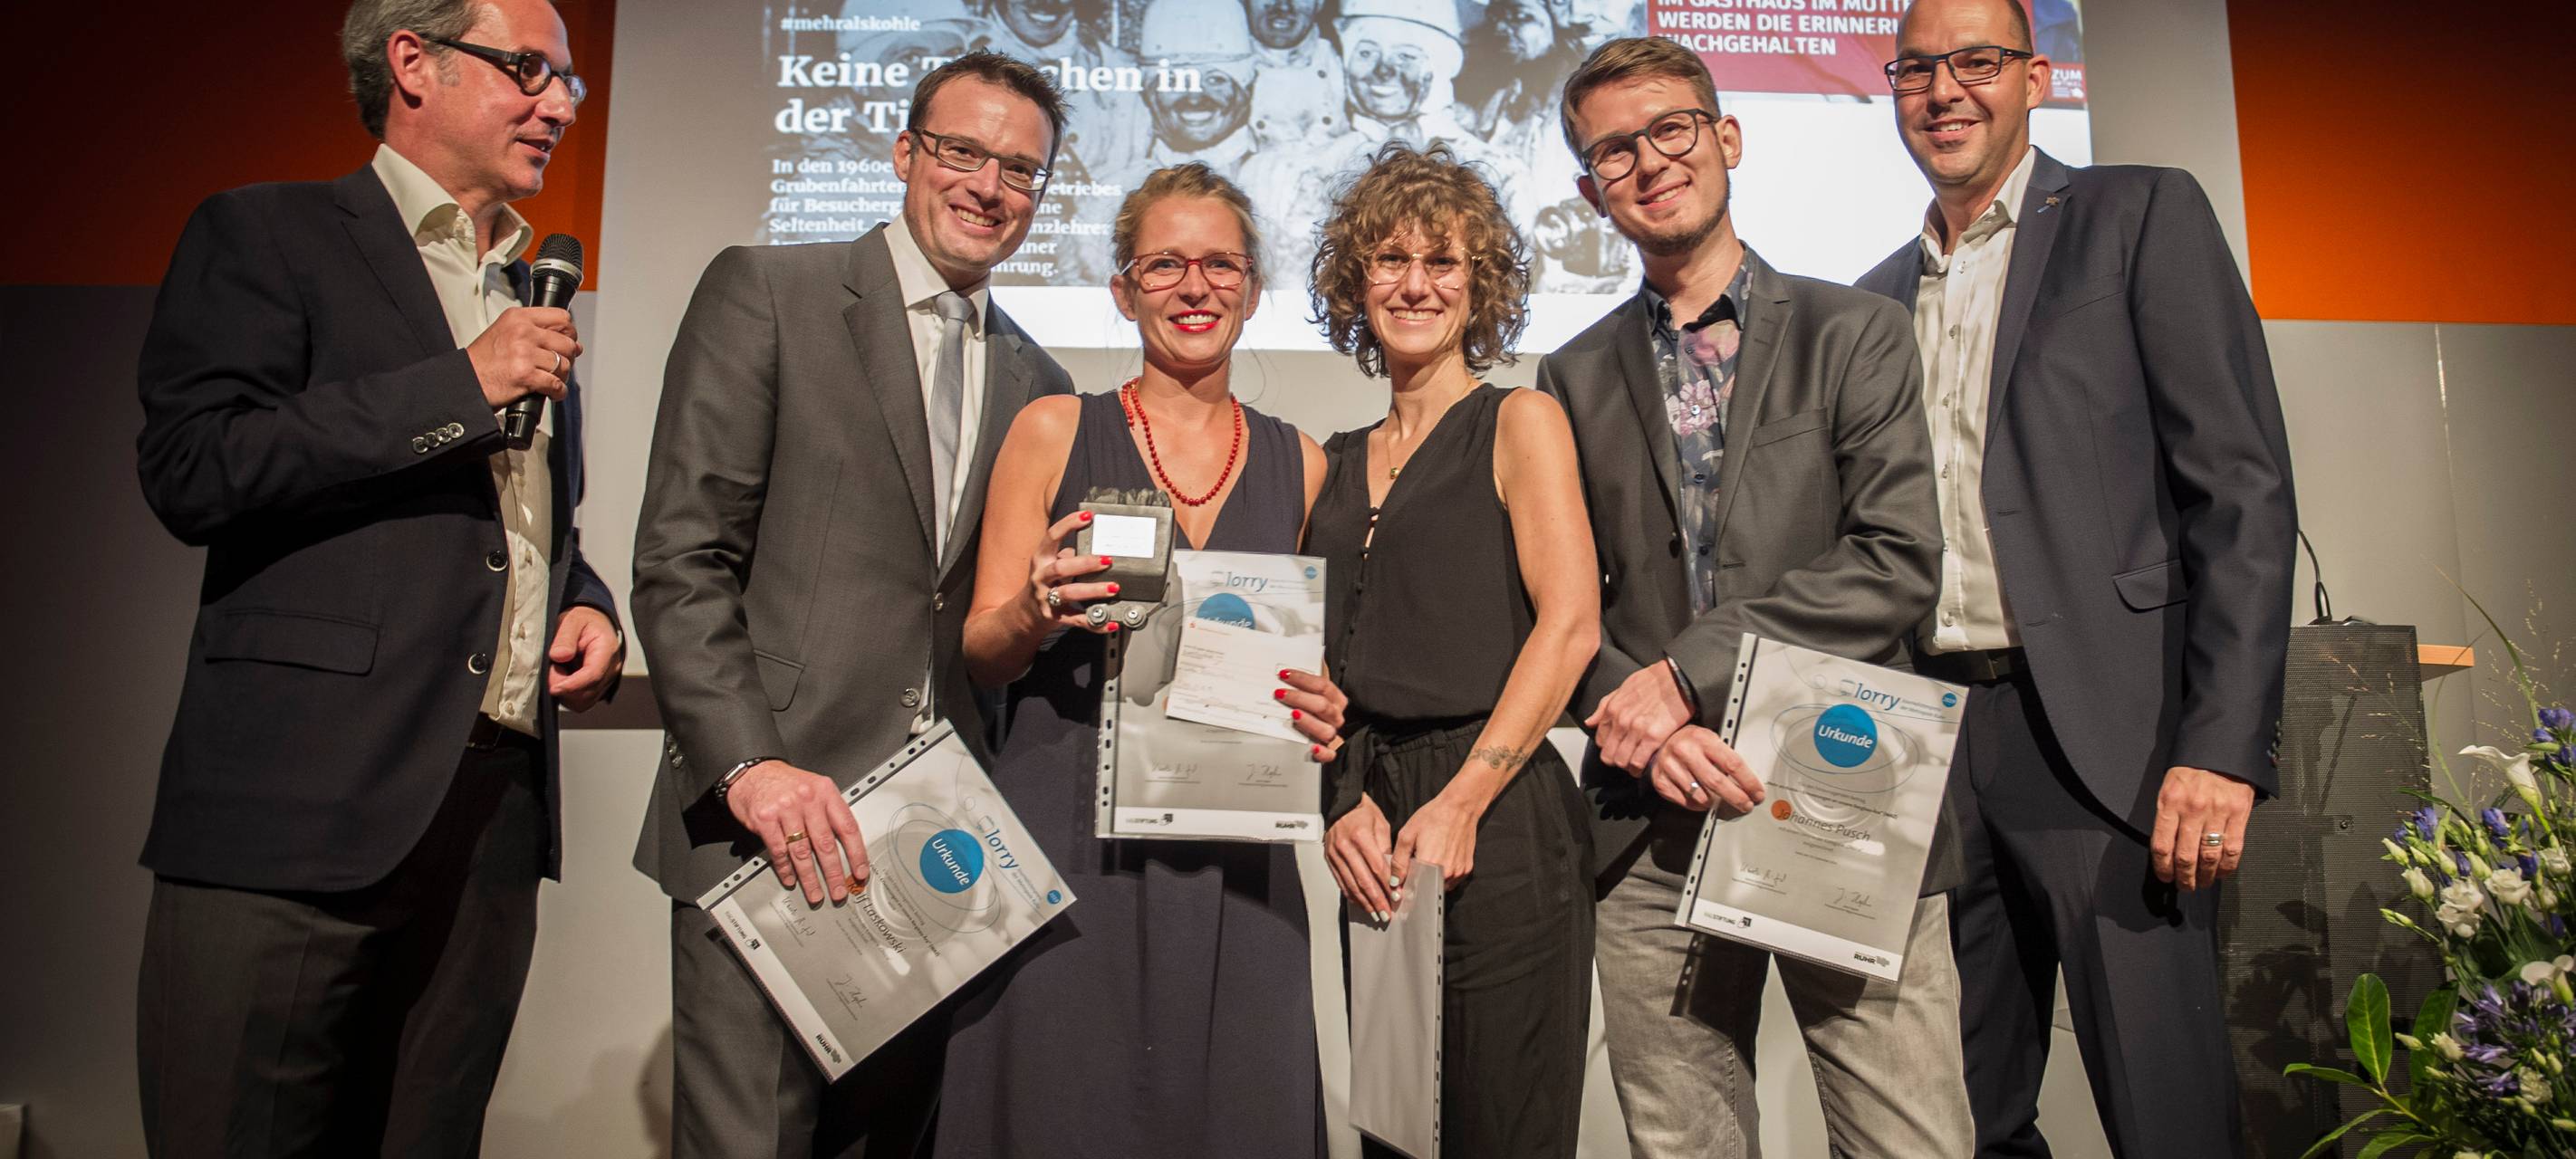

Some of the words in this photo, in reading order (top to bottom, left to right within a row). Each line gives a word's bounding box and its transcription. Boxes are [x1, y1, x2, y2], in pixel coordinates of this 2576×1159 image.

[780, 14, 920, 32] #mehralskohle
[1657, 10, 1751, 31] WERDEN
[1756, 14, 1793, 33] DIE
[776, 52, 909, 88] Keine
[1156, 57, 1203, 92] in
[2051, 68, 2082, 81] ZUM
[774, 98, 852, 134] der
[773, 158, 794, 174] In
[797, 158, 833, 174] den
[770, 196, 800, 214] für
[769, 216, 872, 234] Seltenheit.
[1225, 570, 1269, 593] lorry
[1854, 682, 1902, 711] lorry
[1817, 724, 1874, 750] Urkunde
[1779, 808, 1833, 834] Johannes
[1833, 823, 1871, 841] Pusch
[931, 838, 971, 886] Urkunde
[985, 828, 1021, 870] lorry
[862, 903, 907, 954] Laskowski
